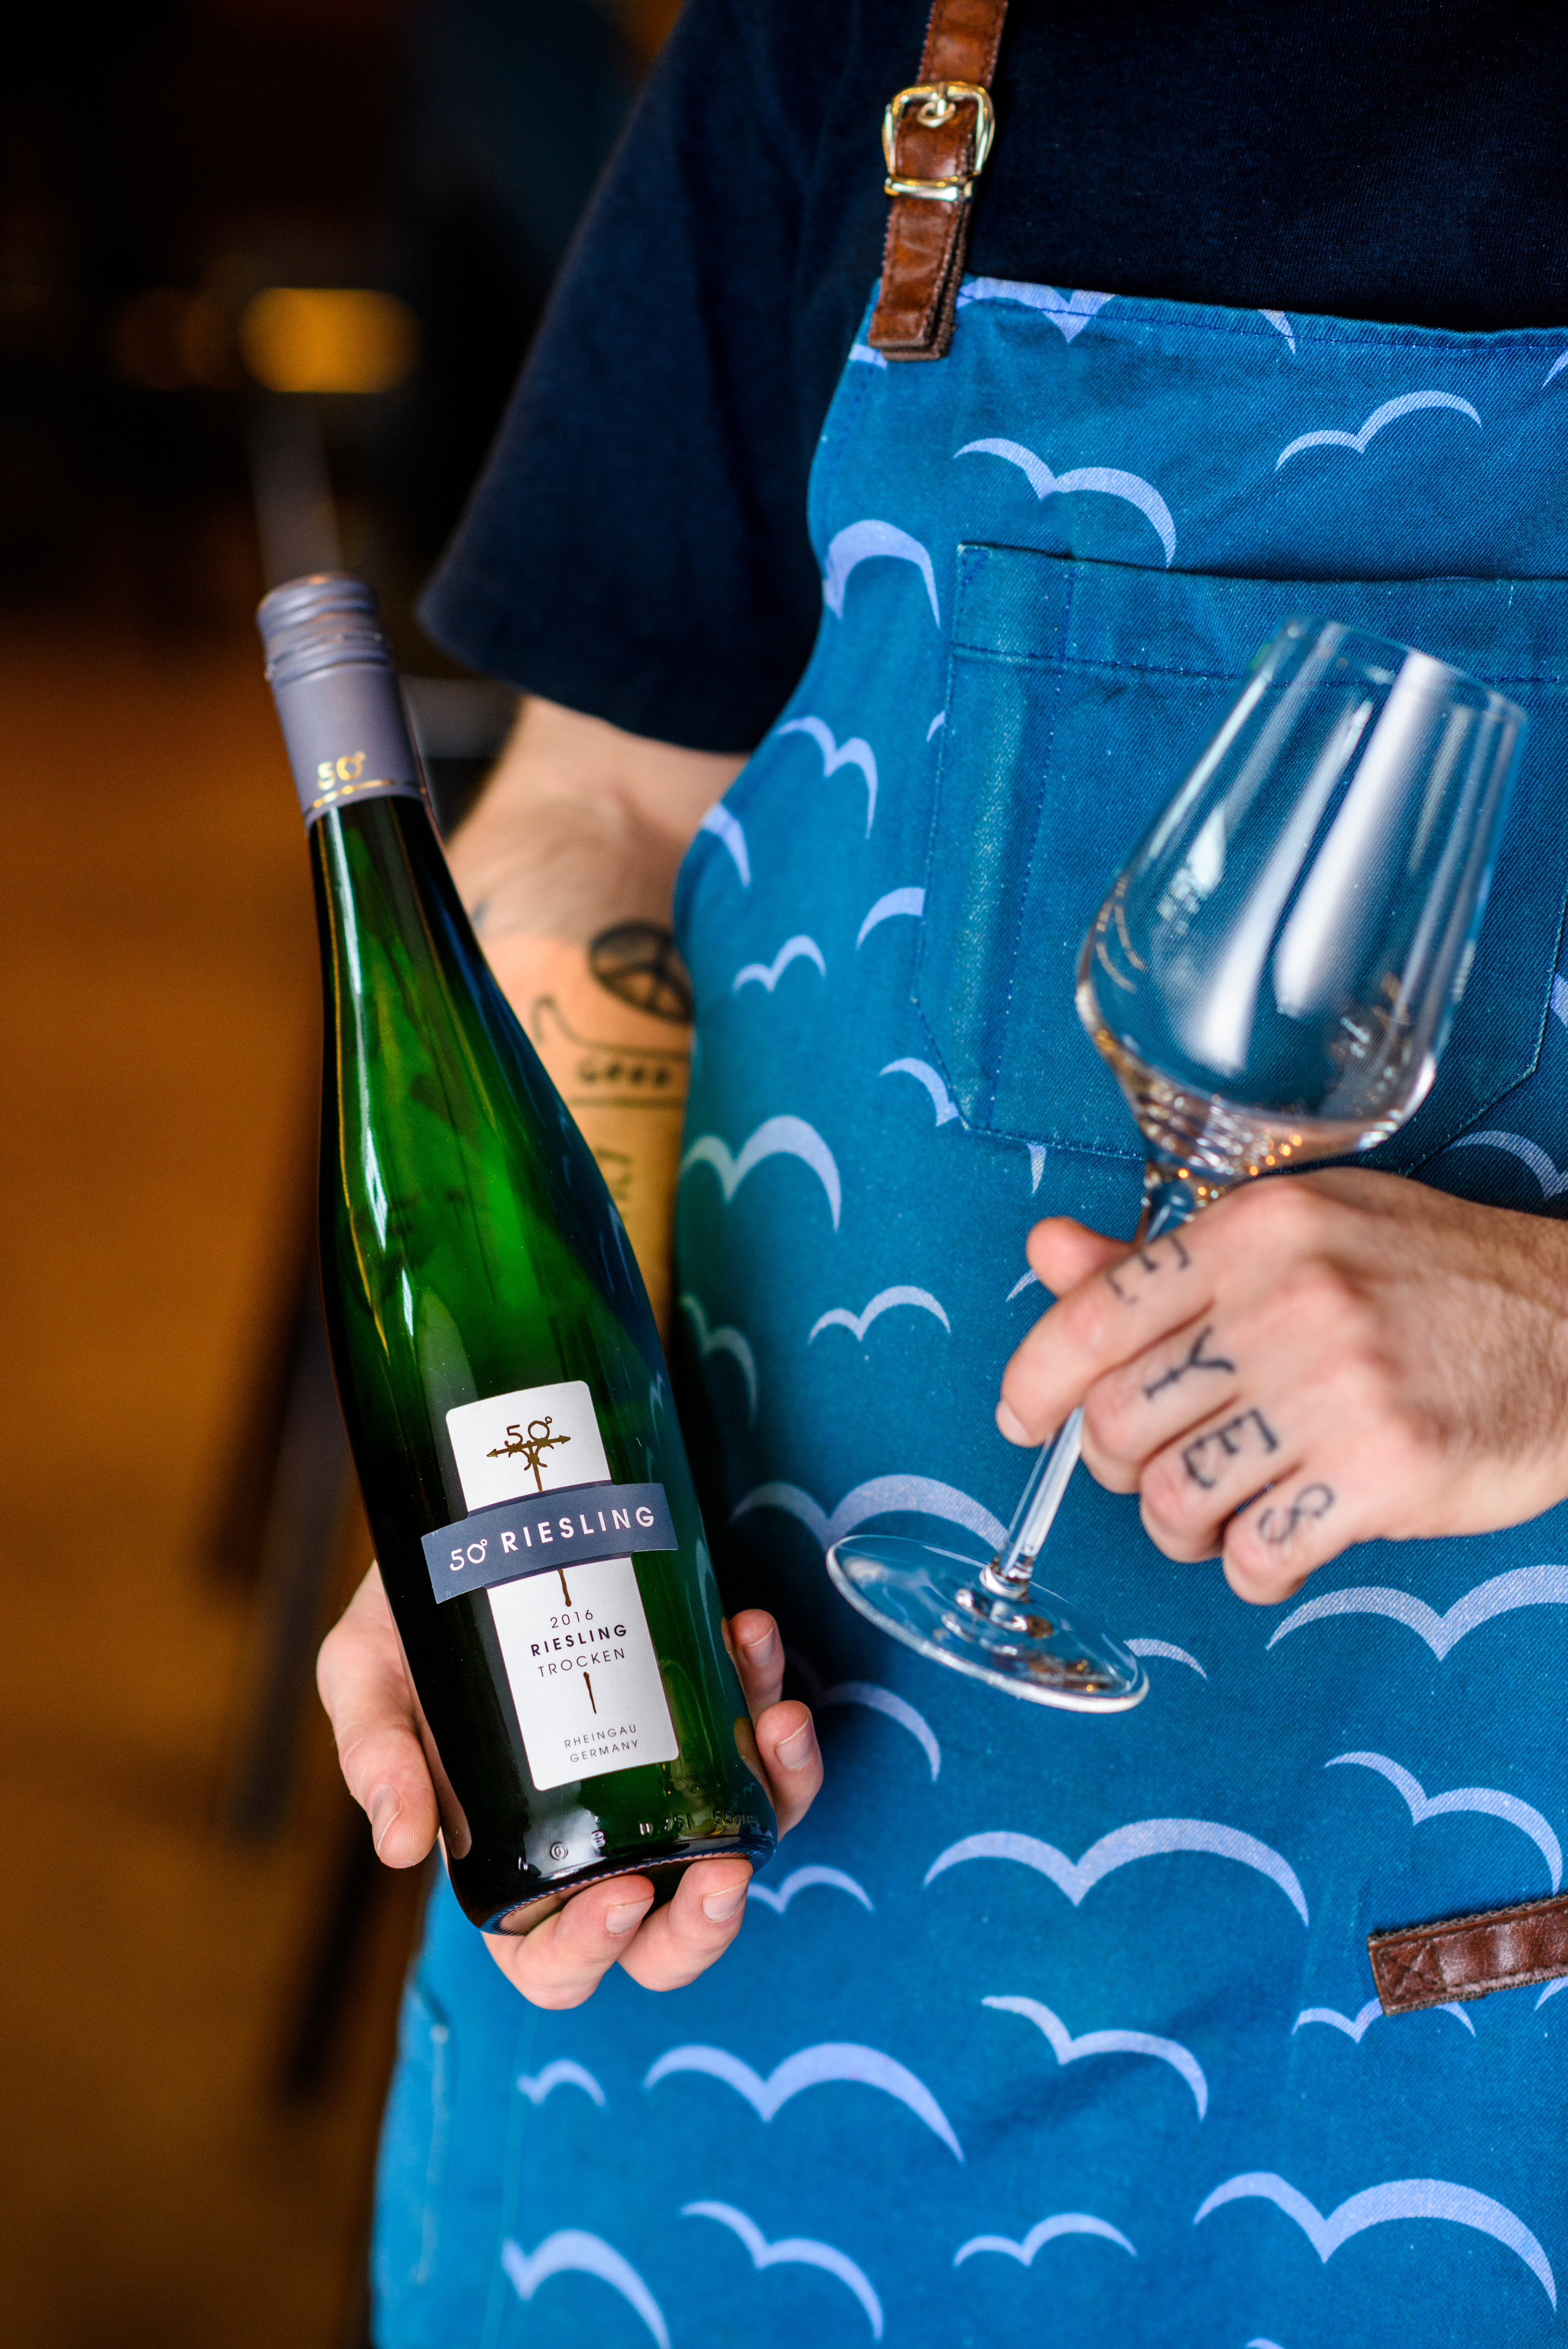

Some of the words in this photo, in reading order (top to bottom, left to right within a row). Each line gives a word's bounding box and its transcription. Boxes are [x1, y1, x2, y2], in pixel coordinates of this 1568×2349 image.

[450, 1539, 488, 1571] 50°
[500, 1507, 655, 1554] RIESLING
[550, 1609, 594, 1629] 2016
[530, 1624, 627, 1657] RIESLING
[538, 1648, 625, 1678] TROCKEN
[564, 1724, 637, 1749] RHEINGAU
[570, 1740, 638, 1763] GERMANY
